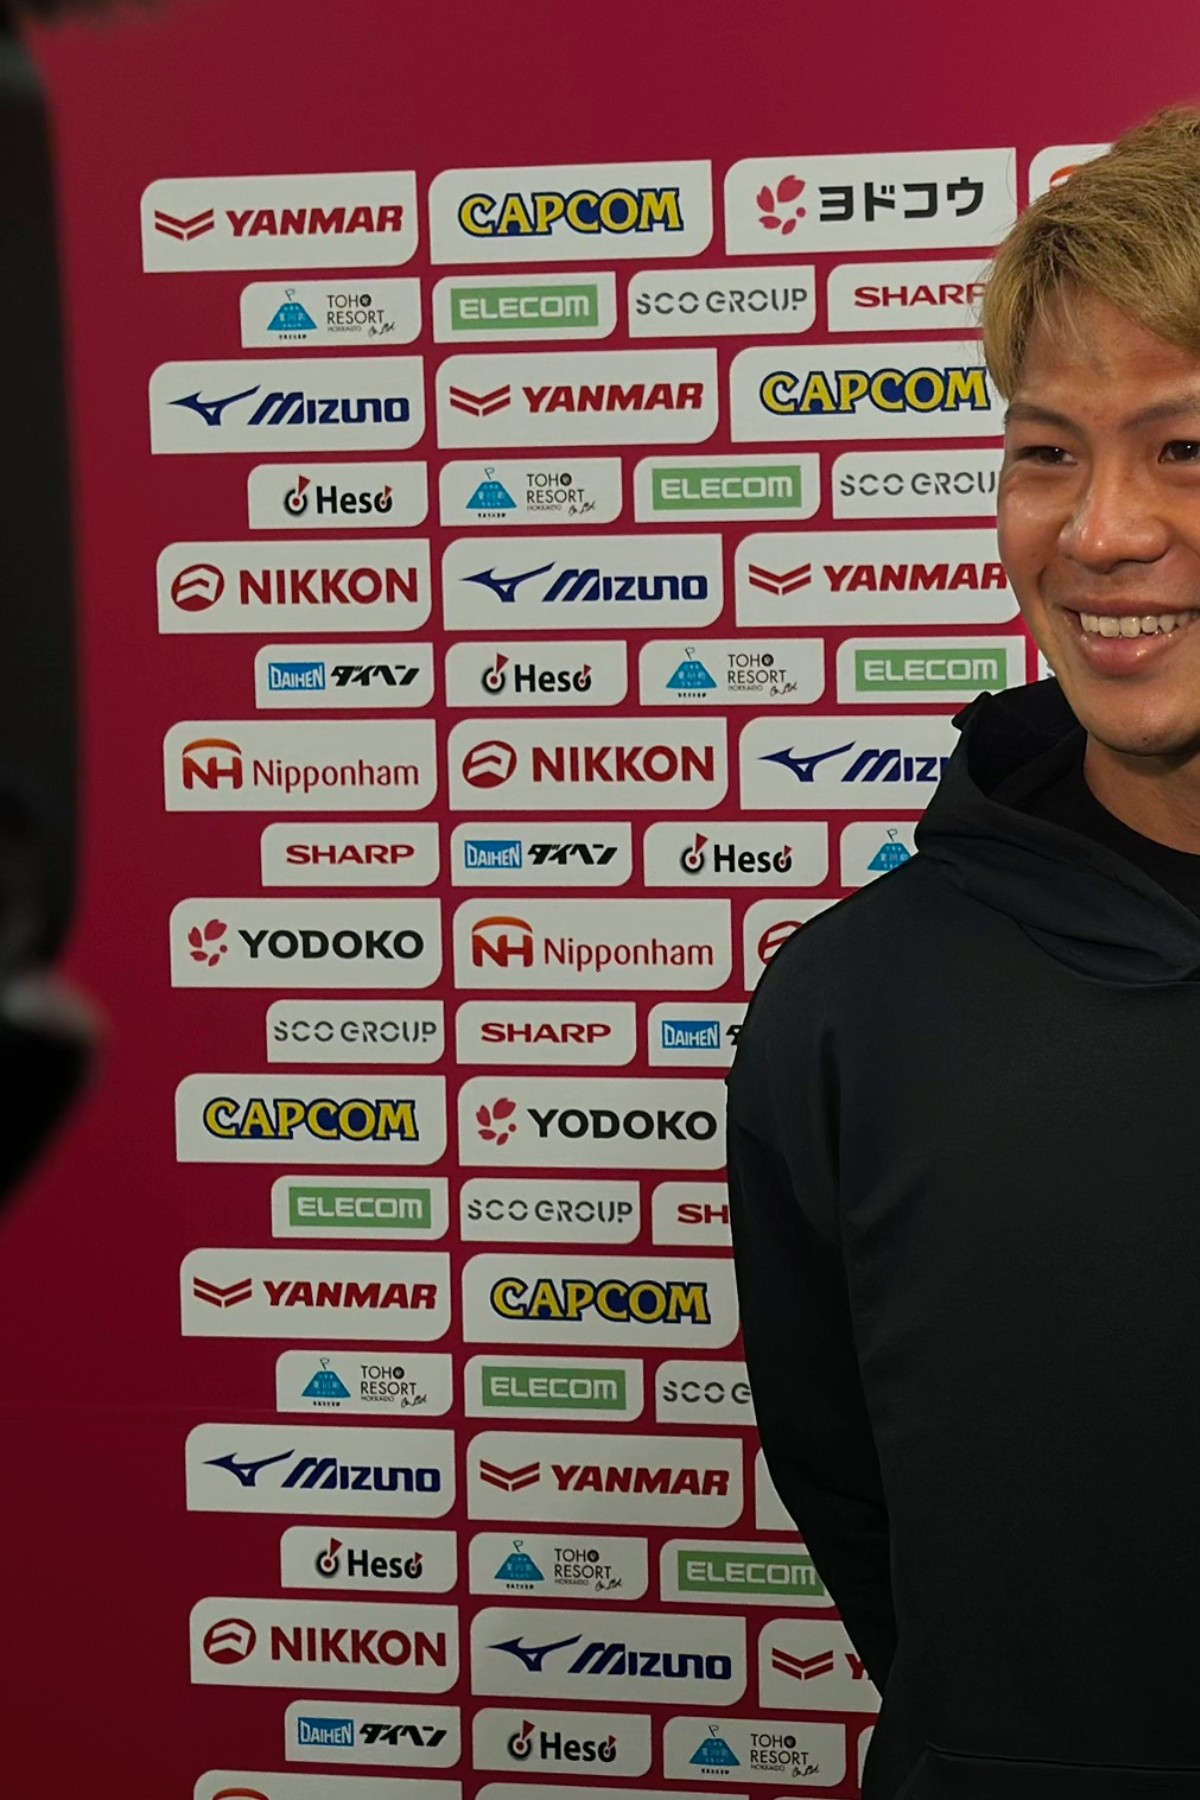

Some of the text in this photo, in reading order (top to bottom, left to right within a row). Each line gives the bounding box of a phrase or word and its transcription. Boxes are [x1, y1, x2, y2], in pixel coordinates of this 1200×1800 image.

[818, 176, 984, 222] ヨドコウ
[225, 205, 404, 237] YANMAR
[457, 187, 684, 238] CAPCOM
[326, 294, 372, 309] TOHO
[459, 295, 590, 319] ELECOM
[636, 288, 807, 315] SCO GROUP
[327, 309, 385, 325] RESORT
[522, 382, 704, 413] YANMAR
[760, 367, 991, 415] CAPCOM
[247, 391, 410, 425] MIZUNO
[526, 472, 572, 488] TOHO
[661, 476, 793, 500] ELECOM
[840, 470, 997, 497] SCO GROU
[316, 485, 393, 514] Heso
[527, 488, 585, 504] RESORT
[239, 567, 418, 605] NIKKON
[541, 568, 708, 602] MIZUNO
[823, 563, 1008, 592] YANMAR
[727, 653, 774, 668] TOHO
[864, 659, 998, 681] ELECOM
[270, 665, 323, 688] DAIHEN
[330, 664, 420, 687] ダイヘン
[514, 663, 592, 693] Heso
[727, 669, 787, 684] RESORT
[253, 759, 419, 794] Nipponham
[532, 745, 714, 783] NIKKON
[286, 844, 415, 865] SHARP
[466, 843, 520, 867] DAIHEN
[527, 843, 618, 865] ダイヘン
[714, 844, 792, 873] Heso
[237, 930, 424, 959] YODOKO
[544, 938, 713, 973] Nipponham
[274, 1020, 437, 1043] SCO GROUP
[481, 1022, 611, 1044] SHARP
[664, 1024, 718, 1046] DAIHEN
[203, 1096, 419, 1142] CAPCOM
[527, 1108, 717, 1141] YODOKO
[297, 1196, 423, 1219] ELECOM
[467, 1199, 633, 1224] SCO GROUP
[263, 1280, 437, 1310] YANMAR
[490, 1277, 711, 1325] CAPCOM
[360, 1365, 405, 1380] TOHO
[360, 1381, 417, 1396] RESORT
[490, 1376, 617, 1400] ELECOM
[663, 1381, 725, 1404] SCO
[280, 1457, 441, 1493] MIZUNO
[550, 1464, 730, 1496] YANMAR
[347, 1548, 423, 1579] Heso
[554, 1548, 600, 1563] TOHO
[554, 1564, 612, 1579] RESORT
[270, 1626, 447, 1667] NIKKON
[567, 1642, 731, 1680] MIZUNO
[300, 1720, 352, 1745] DAIHEN
[359, 1723, 447, 1747] ダイヘン
[750, 1733, 796, 1749] TOHO
[540, 1731, 616, 1763] Heso
[750, 1749, 809, 1765] RESORT
